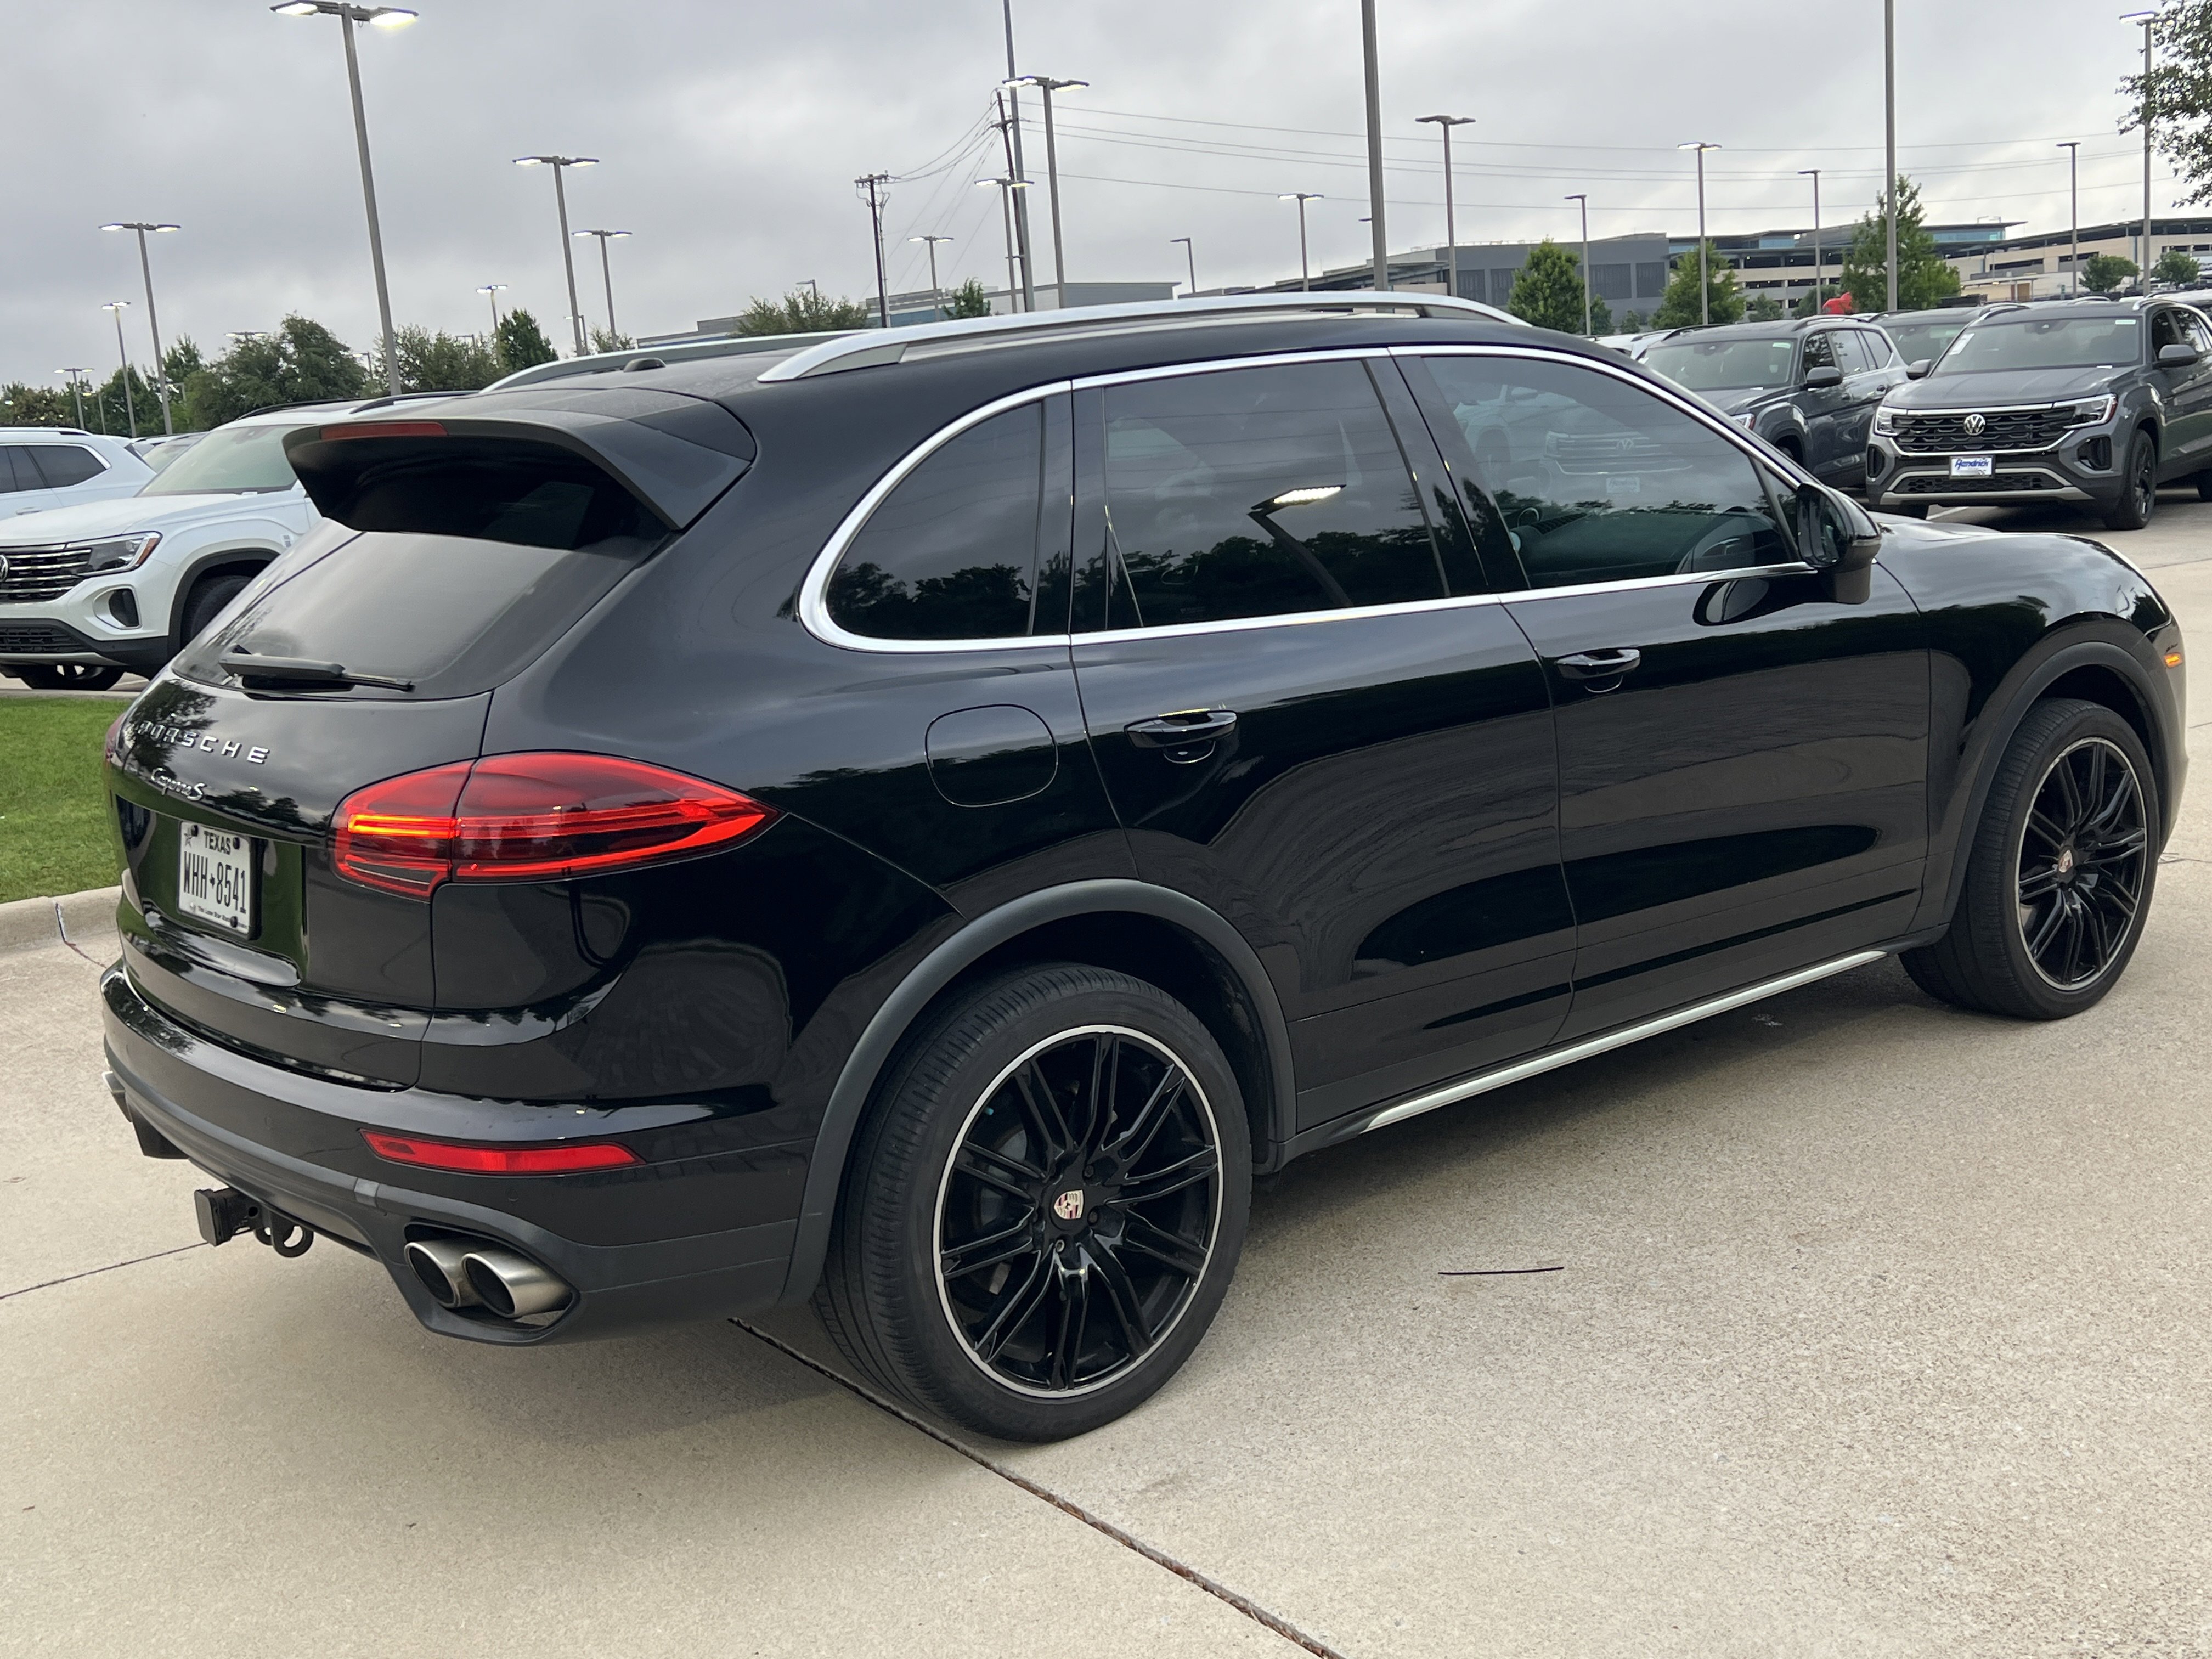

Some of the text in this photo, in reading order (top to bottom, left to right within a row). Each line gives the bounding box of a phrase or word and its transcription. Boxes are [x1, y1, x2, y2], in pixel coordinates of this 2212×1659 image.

[1955, 459, 1989, 470] Hendrick
[138, 720, 270, 764] PORSCHE
[204, 831, 231, 855] TEXAS
